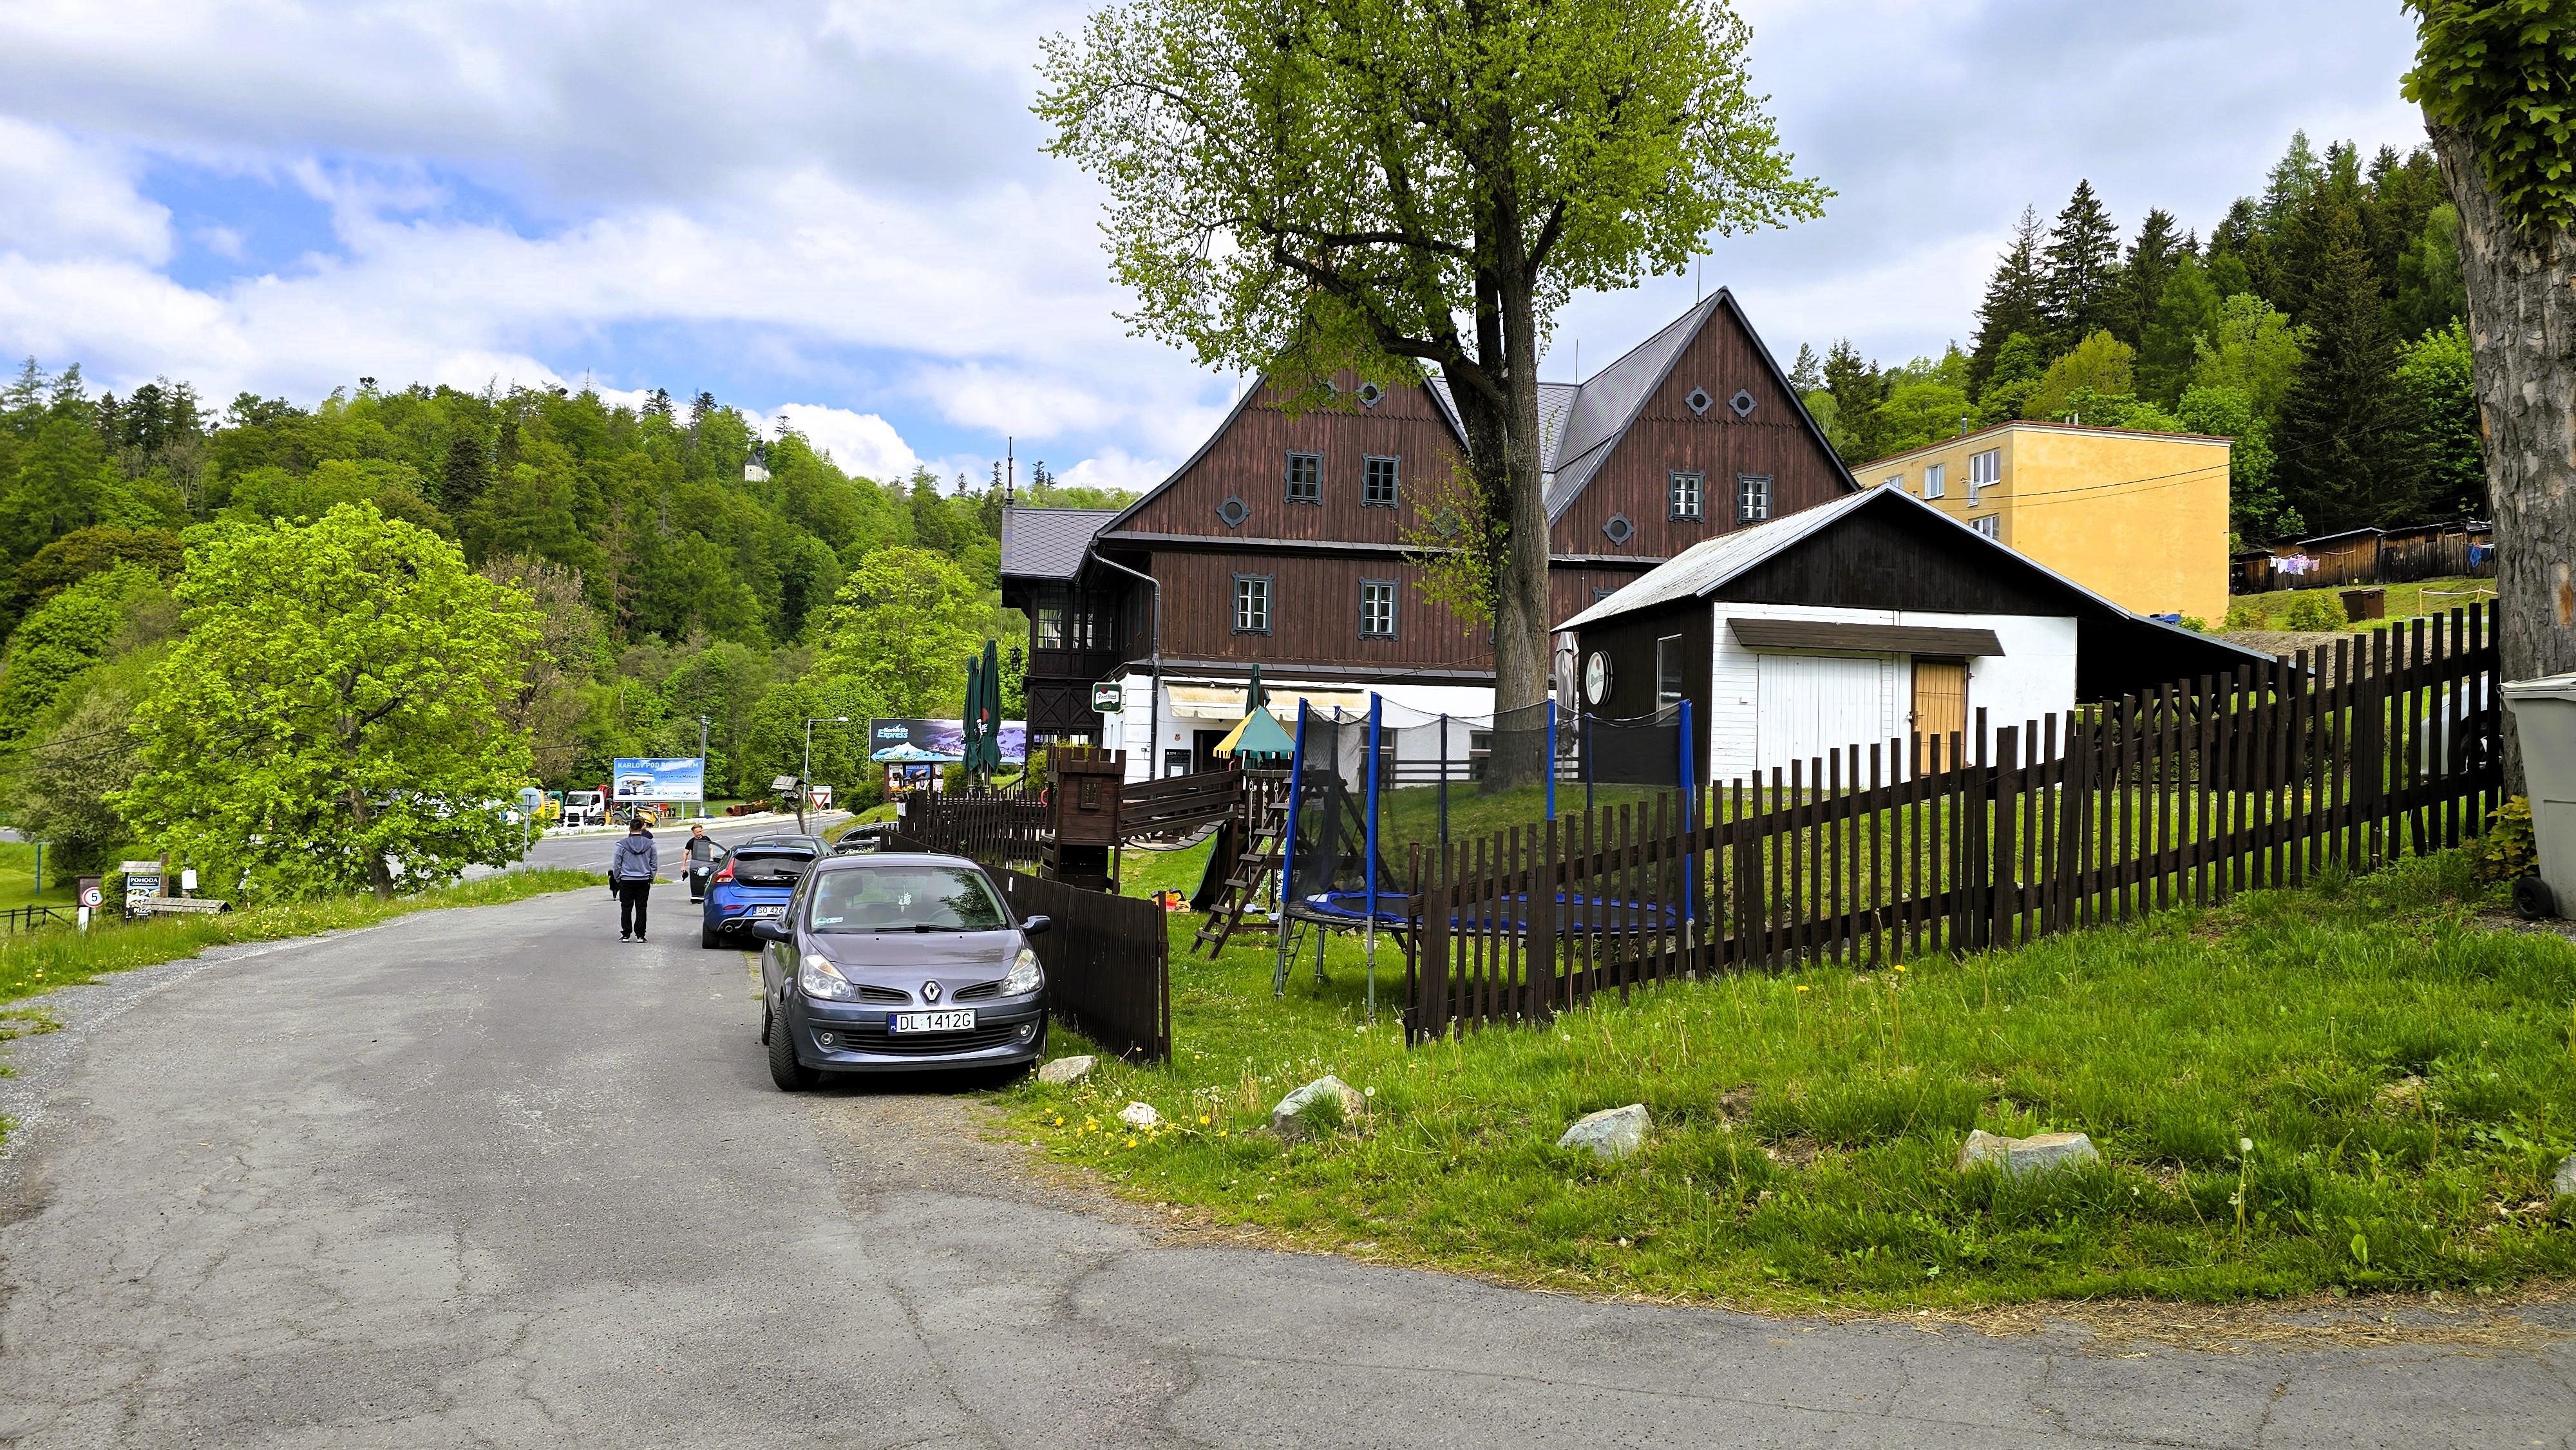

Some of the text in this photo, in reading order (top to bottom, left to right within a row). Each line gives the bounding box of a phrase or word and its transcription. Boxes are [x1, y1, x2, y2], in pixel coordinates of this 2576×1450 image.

[877, 728, 908, 739] Express
[91, 892, 97, 901] 5
[900, 1013, 971, 1030] DL 1412G
